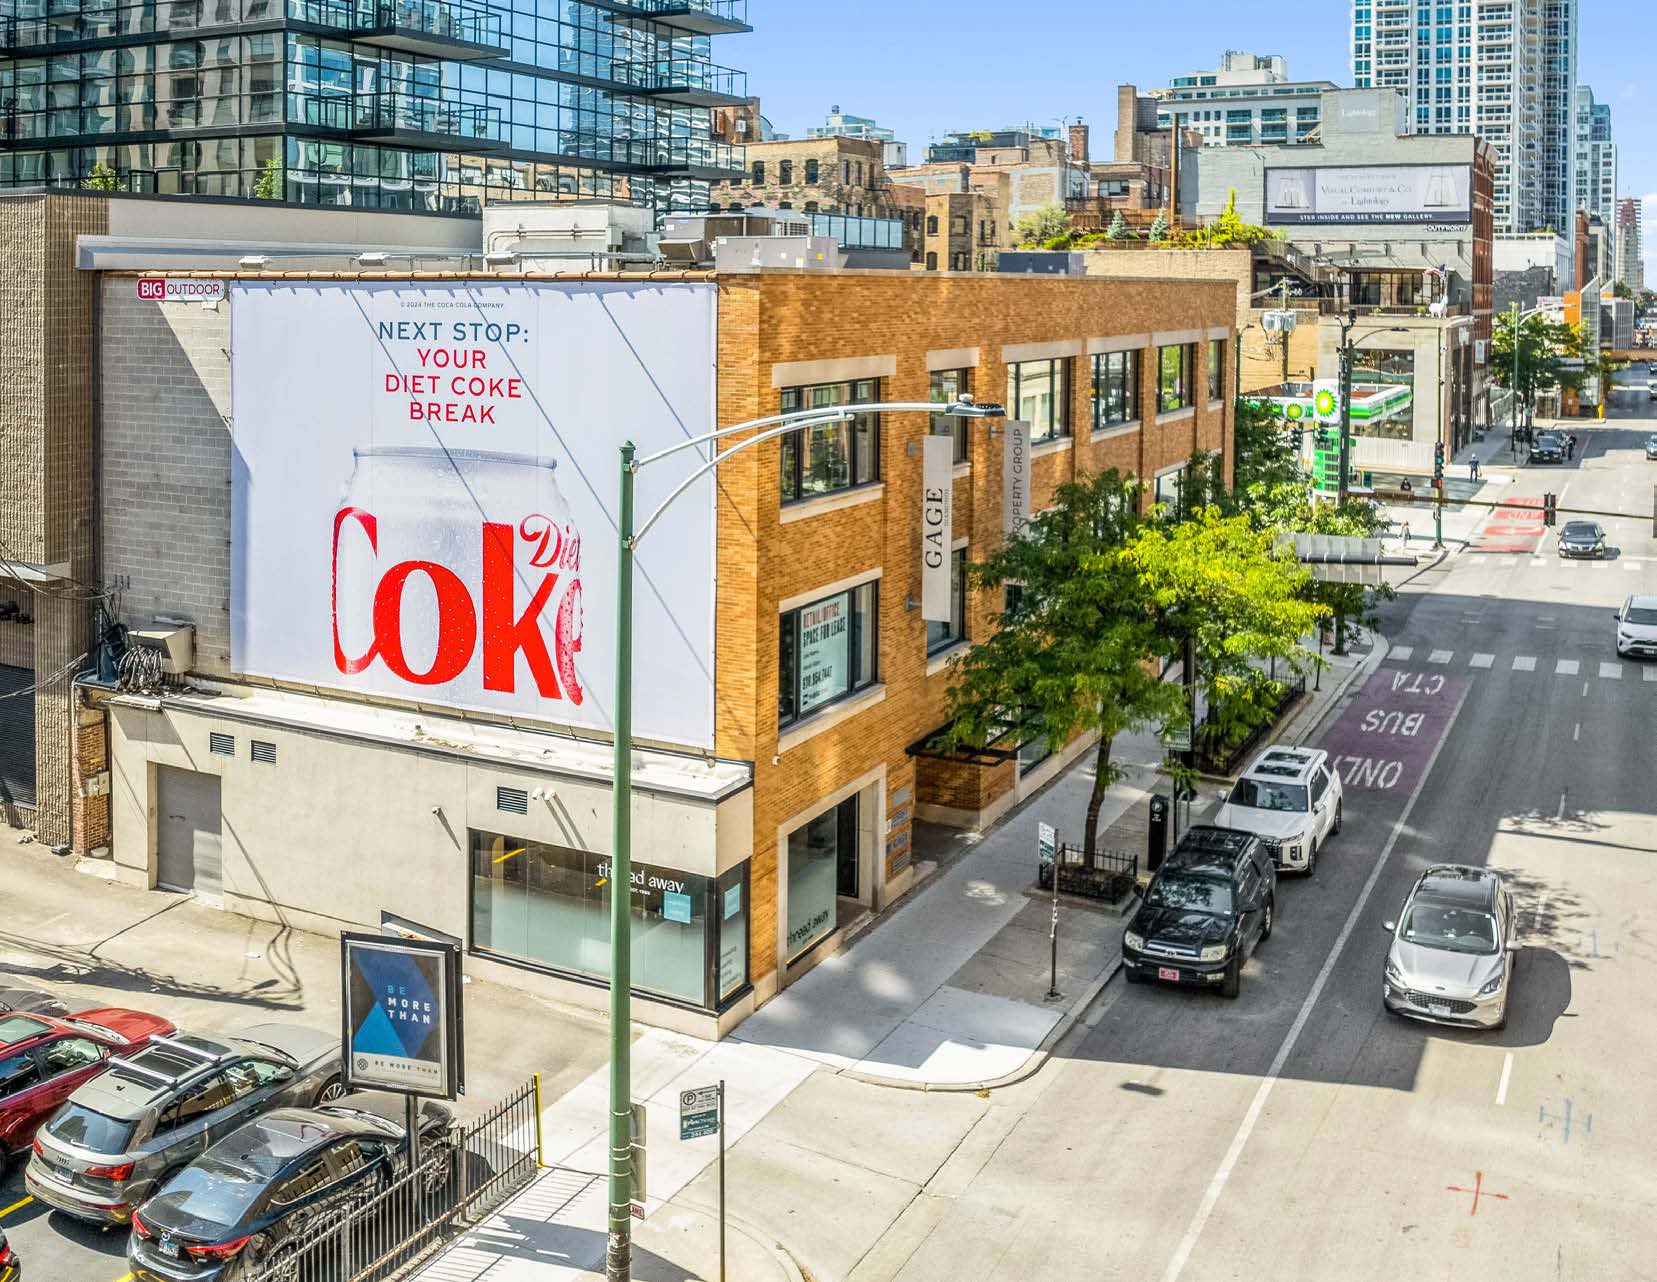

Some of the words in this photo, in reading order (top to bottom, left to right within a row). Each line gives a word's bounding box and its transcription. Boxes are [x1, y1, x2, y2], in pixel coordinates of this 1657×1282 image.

[141, 281, 163, 296] BIG
[166, 283, 220, 295] OUTDOOR
[378, 321, 443, 341] NEXT
[453, 322, 529, 343] STOP:
[417, 347, 487, 369] YOUR
[385, 374, 441, 394] DIET
[451, 376, 522, 398] COKE
[409, 401, 495, 424] BREAK
[1012, 428, 1024, 474] GROUP
[1012, 477, 1024, 535] ROPERTY
[925, 488, 943, 569] GAGE
[331, 506, 583, 706] Coke
[803, 626, 819, 648] SPACE
[820, 620, 830, 641] FOR
[831, 615, 846, 637] LEASE
[1391, 671, 1445, 695] CTA
[1361, 709, 1425, 736] BUS
[597, 863, 644, 885] thad
[648, 876, 684, 894] away
[387, 985, 406, 995] BE
[388, 997, 431, 1012] MORE
[388, 1009, 431, 1024] THAN
